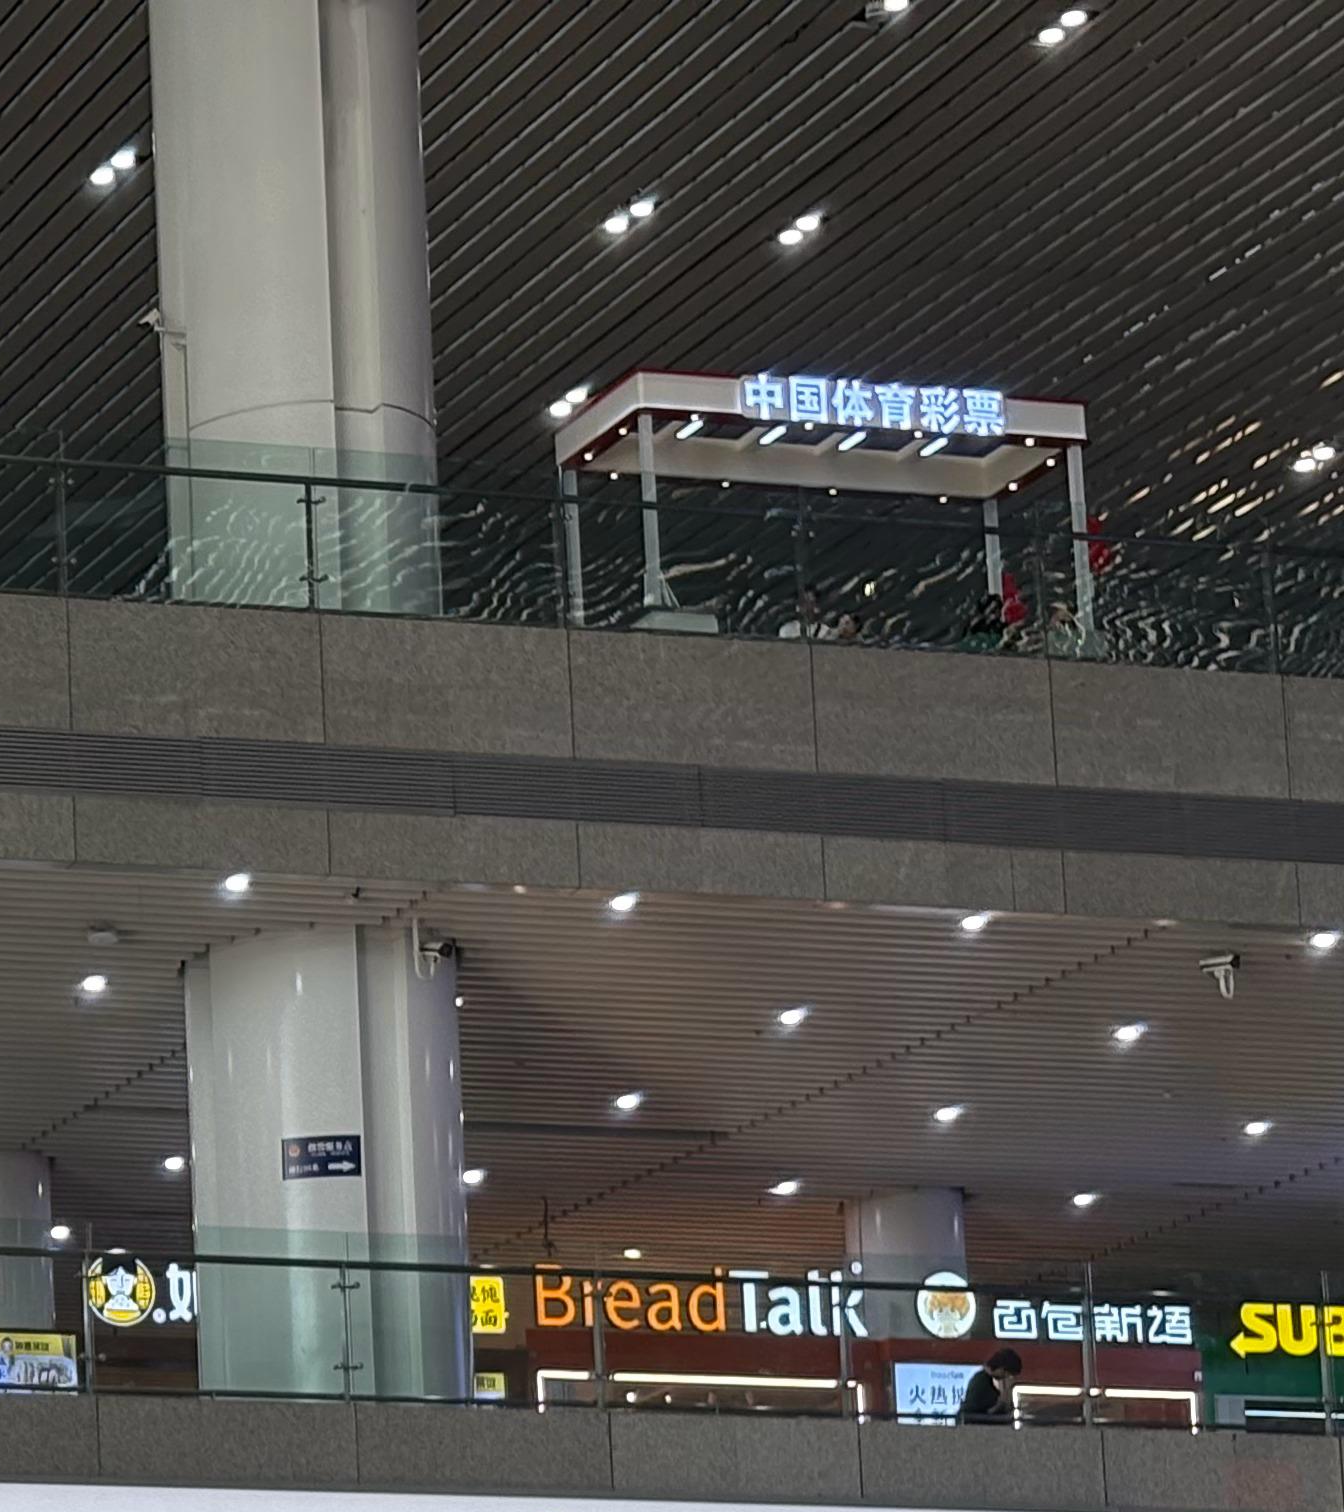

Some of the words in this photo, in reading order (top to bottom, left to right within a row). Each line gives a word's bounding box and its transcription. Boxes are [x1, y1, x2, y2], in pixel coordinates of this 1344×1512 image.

[744, 372, 1005, 436] 中国体育彩票
[535, 1262, 870, 1338] BreadTalk
[993, 1298, 1192, 1347] 面包新语
